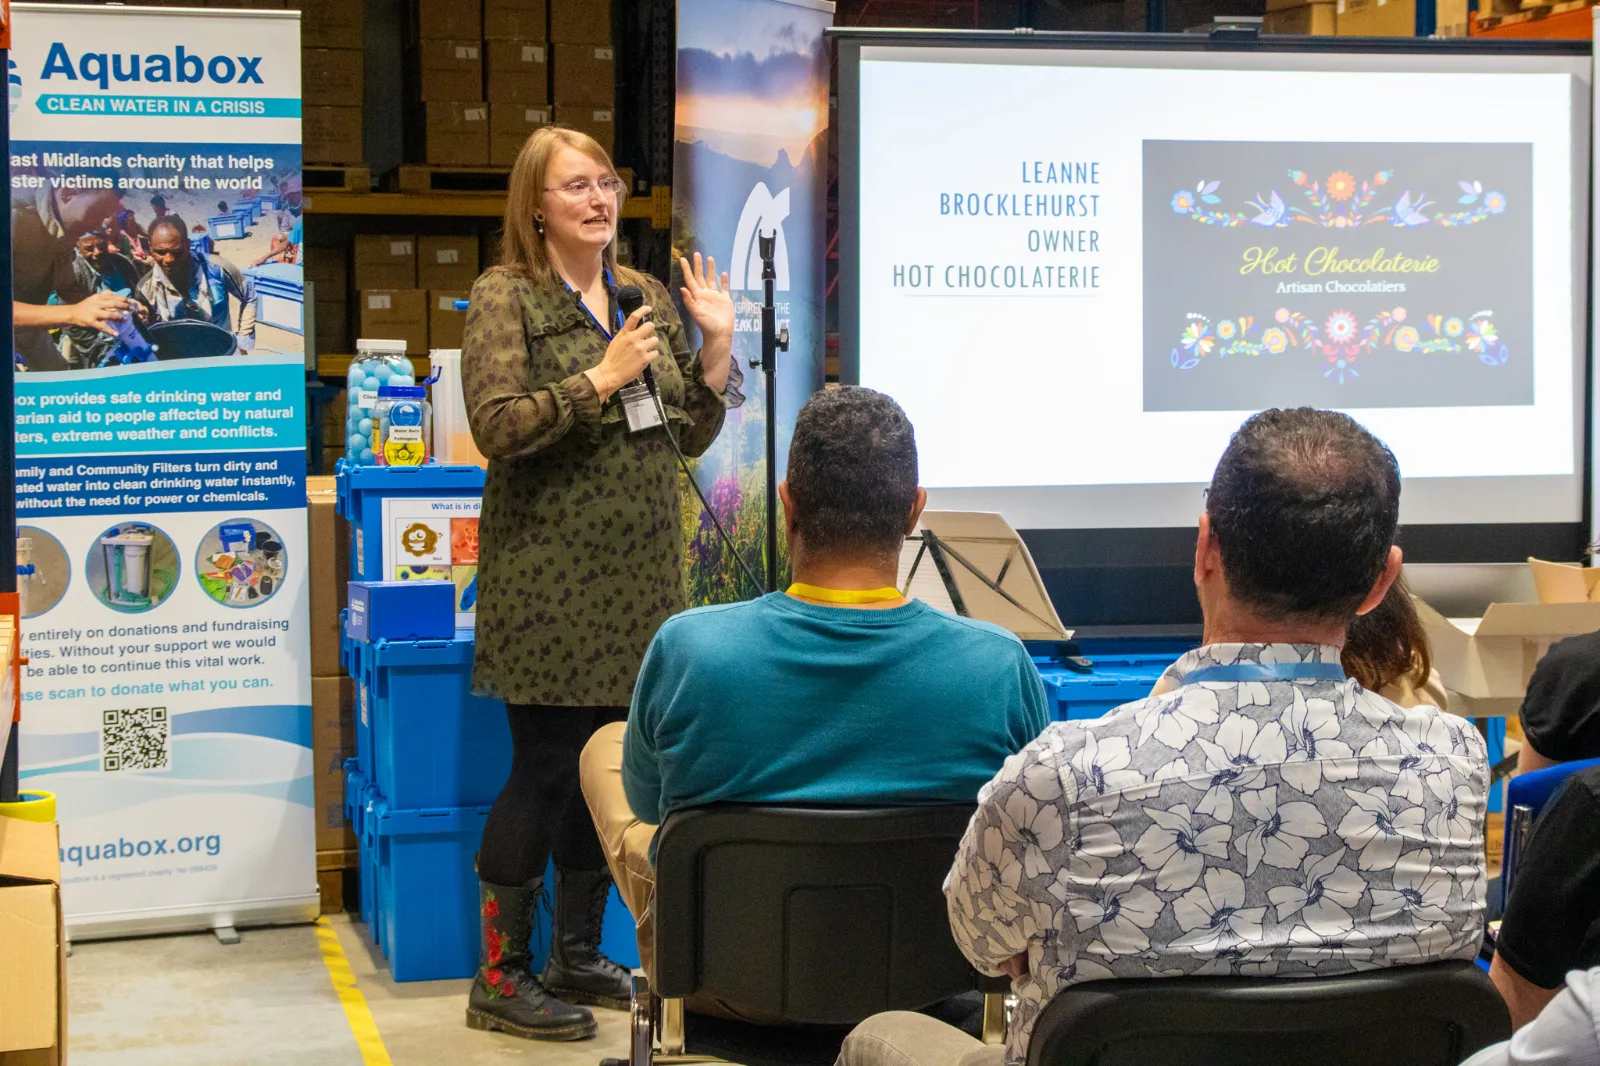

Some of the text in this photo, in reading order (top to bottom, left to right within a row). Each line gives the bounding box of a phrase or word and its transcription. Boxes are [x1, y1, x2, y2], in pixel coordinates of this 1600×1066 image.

[40, 42, 264, 89] Aquabox
[47, 98, 265, 114] CLEAN WATER IN A CRISIS
[43, 153, 122, 168] Midlands
[127, 154, 186, 172] charity
[191, 155, 223, 169] that
[228, 155, 274, 173] helps
[1022, 161, 1099, 184] LEANNE
[50, 174, 113, 189] victims
[118, 175, 179, 190] around
[183, 175, 210, 190] the
[215, 175, 262, 190] world
[940, 192, 1099, 217] BROCKLEHURST
[1028, 229, 1099, 252] OWNER
[1240, 246, 1440, 276] Hot Chocolaterie
[893, 264, 1100, 288] HOT CHOCOLATERIE
[1276, 280, 1406, 293] Artisan Chocolatiers
[776, 302, 790, 314] THE
[40, 392, 106, 408] provides
[110, 391, 142, 404] safe
[145, 390, 207, 405] drinking
[211, 390, 251, 402] water
[255, 389, 281, 401] and
[58, 411, 82, 423] aid
[86, 411, 101, 423] to
[105, 410, 156, 425] people
[159, 408, 219, 421] affected
[223, 407, 240, 423] by
[244, 406, 294, 419] natural
[52, 430, 113, 442] extreme
[116, 428, 176, 441] weather
[180, 426, 207, 439] and
[211, 425, 278, 438] conflicts.
[49, 465, 73, 477] and
[76, 463, 149, 476] Community
[152, 461, 192, 473] Filters
[195, 462, 220, 473] turn
[223, 460, 252, 473] dirty
[254, 460, 278, 471] and
[46, 481, 82, 492] water
[85, 480, 110, 491] into
[113, 479, 147, 490] clean
[150, 477, 202, 490] drinking
[205, 476, 239, 488] water
[242, 475, 295, 487] instantly,
[16, 491, 268, 509] without the need for power or chemicals.
[29, 628, 82, 641] entirely
[86, 629, 104, 638] on
[108, 624, 178, 638] donations
[182, 621, 208, 633] and
[212, 618, 289, 631] fundraising
[59, 645, 114, 657] Without
[118, 643, 150, 657] your
[154, 639, 208, 654] support
[212, 640, 231, 649] we
[235, 636, 276, 648] would
[27, 654, 265, 677] be able to continue this vital work.
[48, 688, 86, 700] scan
[91, 685, 106, 697] to
[110, 682, 164, 695] donate
[168, 679, 204, 692] what
[209, 679, 237, 693] you
[242, 678, 273, 688] can.
